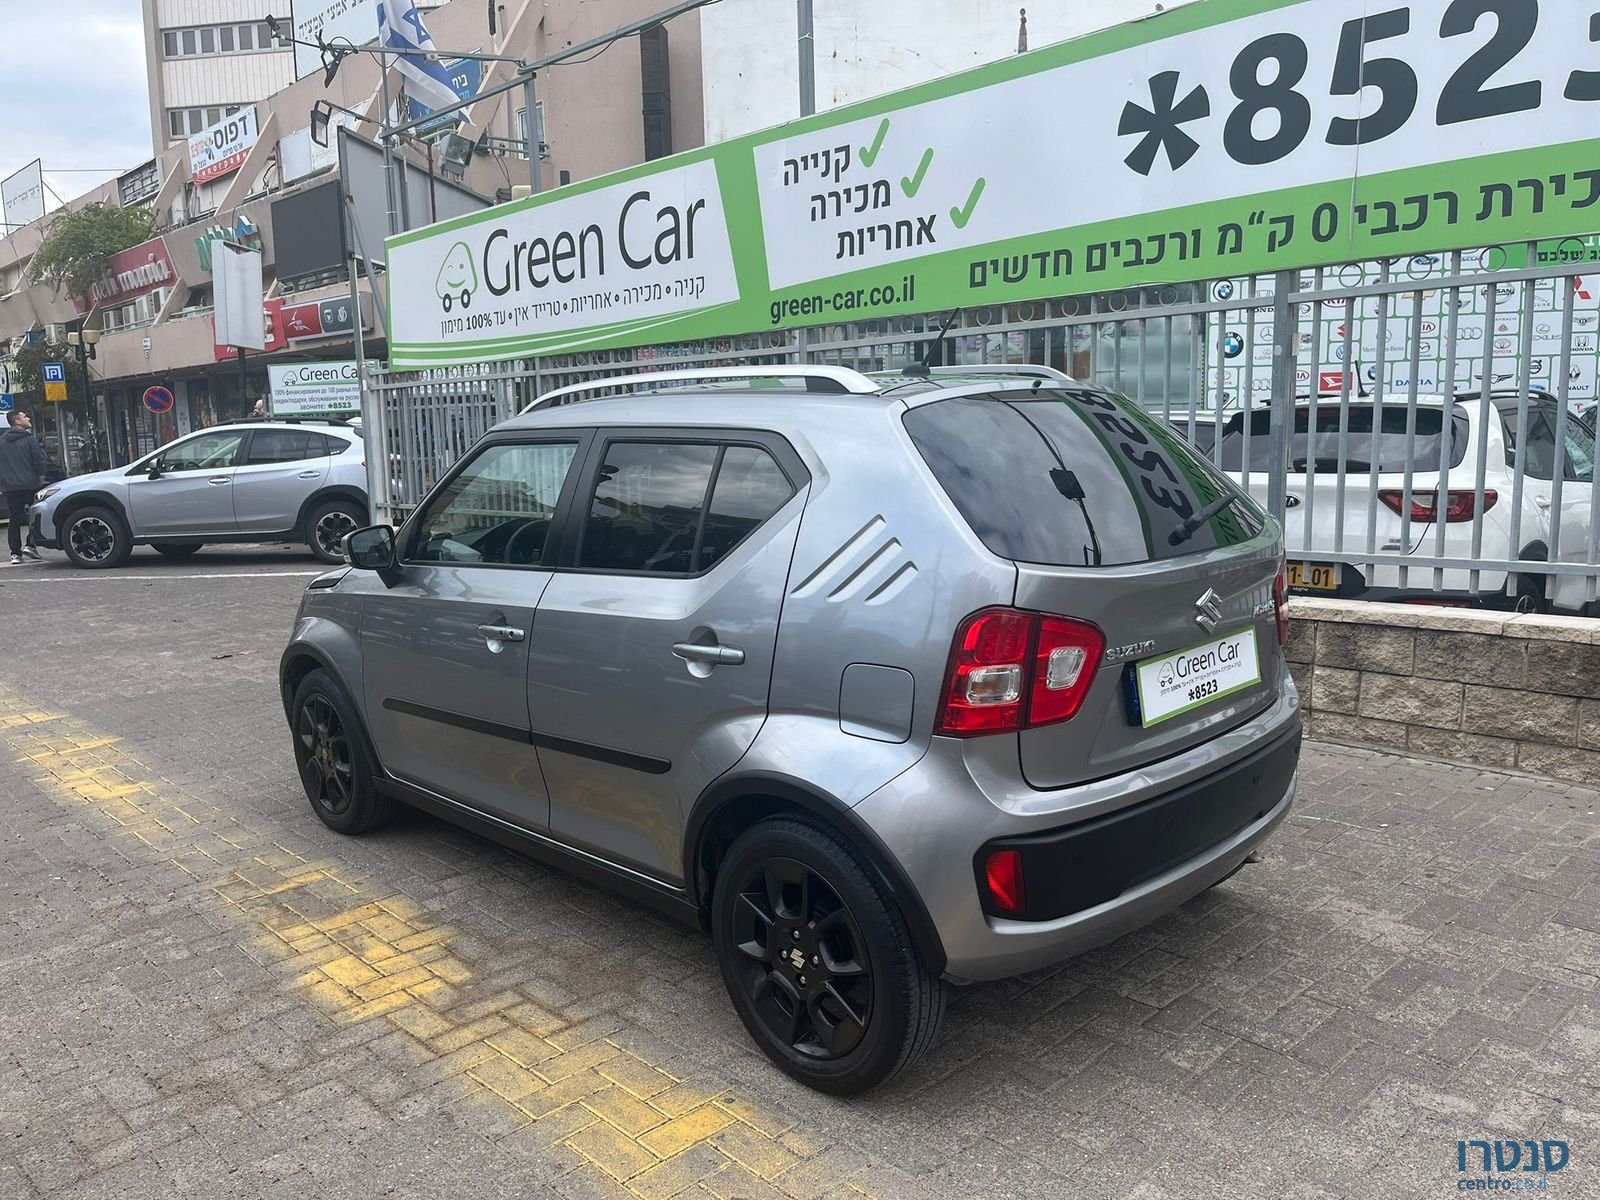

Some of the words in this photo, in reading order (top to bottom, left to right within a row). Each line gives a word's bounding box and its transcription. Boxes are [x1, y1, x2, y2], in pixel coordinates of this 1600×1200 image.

[213, 115, 248, 150] דפוס
[783, 144, 851, 186] קנייה
[810, 179, 891, 222] מכירה
[1353, 191, 1458, 236] רכבי
[836, 214, 937, 260] אחריות
[1312, 202, 1338, 243] 0
[483, 224, 605, 297] Green
[618, 190, 705, 270] Car
[1086, 228, 1201, 273] ורכבים
[969, 248, 1072, 288] חדשים
[570, 291, 612, 314] אחריות
[623, 283, 662, 305] מכירה
[674, 276, 705, 300] קניה
[770, 274, 915, 325] green-car.co.il
[466, 312, 493, 331] 100%
[494, 310, 506, 326] עד
[514, 306, 529, 327] אין
[532, 300, 561, 319] טרייד
[440, 318, 463, 339] מימון
[300, 367, 339, 381] Green
[341, 364, 358, 379] Ca
[1396, 379, 1433, 387] DAIA
[1176, 652, 1216, 678] Green
[1217, 642, 1240, 663] Car
